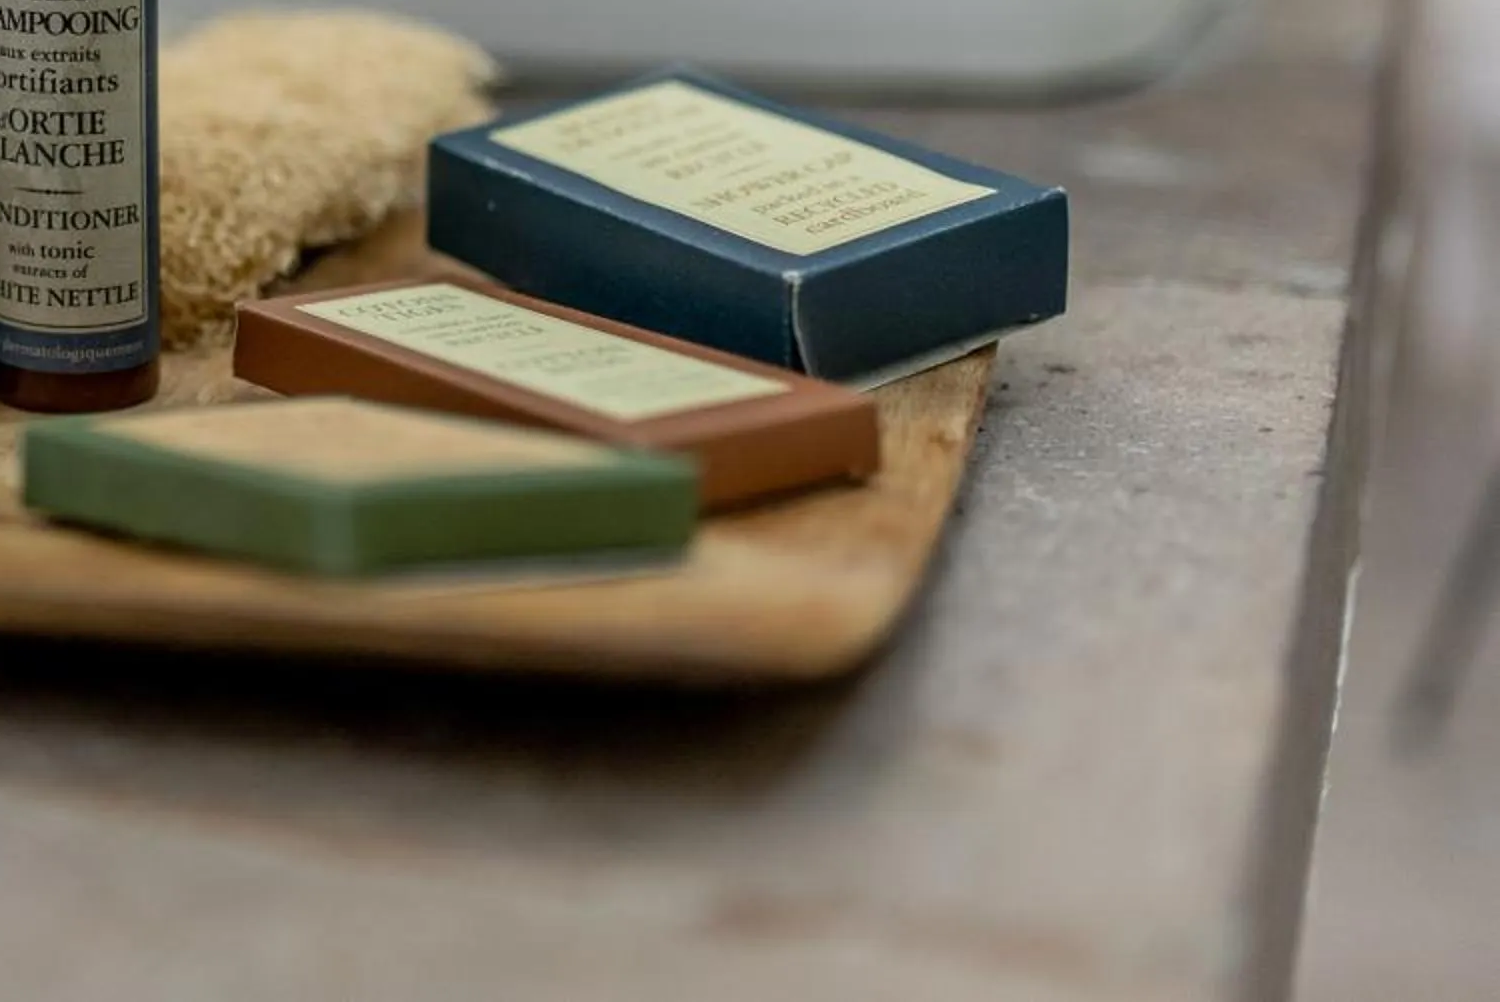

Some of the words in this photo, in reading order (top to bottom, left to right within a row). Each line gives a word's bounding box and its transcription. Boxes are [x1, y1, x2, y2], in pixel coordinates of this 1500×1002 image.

[0, 45, 26, 59] aux
[31, 45, 101, 63] extraits
[8, 242, 35, 258] with
[40, 240, 96, 260] tonic
[13, 264, 67, 279] extracts
[72, 264, 89, 279] of
[46, 280, 140, 307] NETTLE
